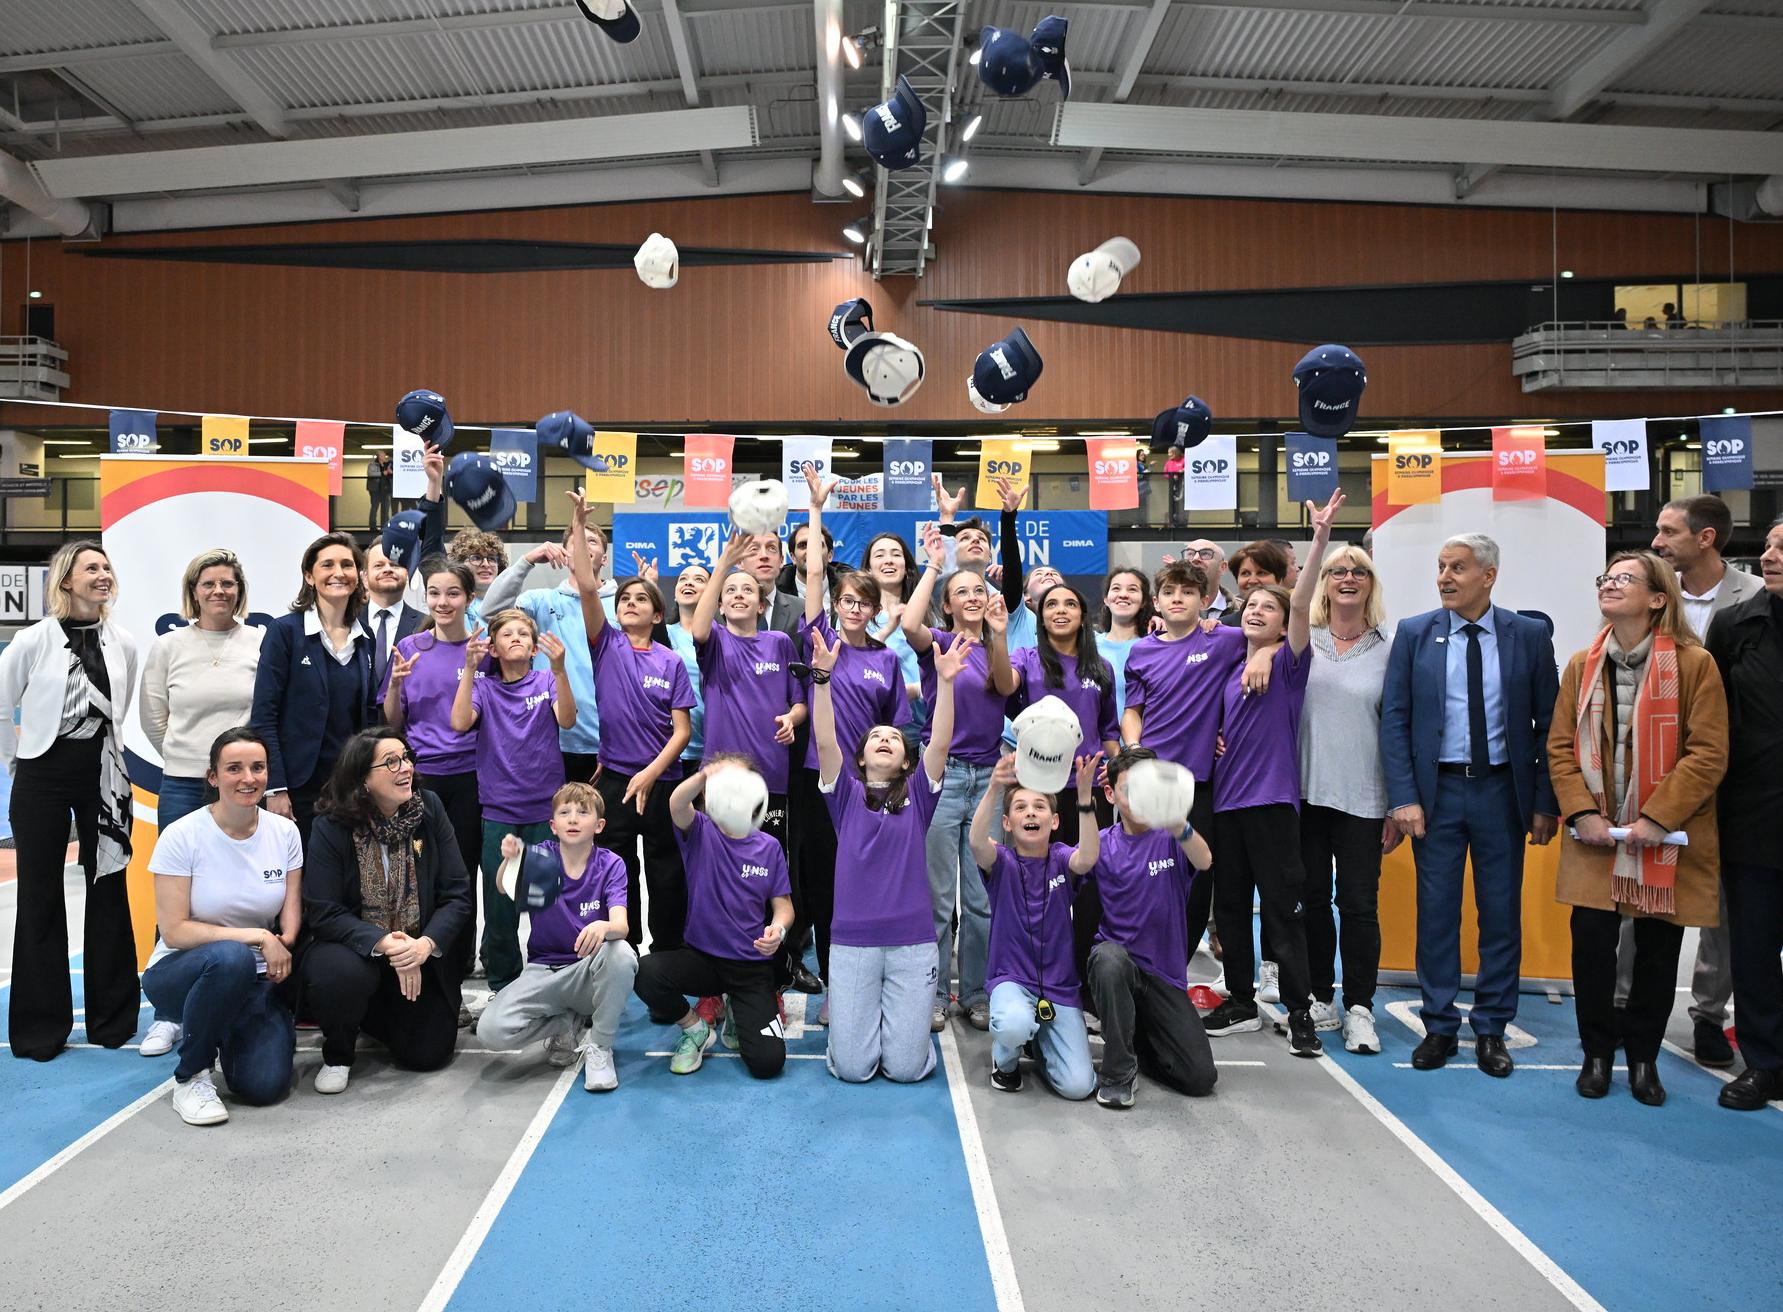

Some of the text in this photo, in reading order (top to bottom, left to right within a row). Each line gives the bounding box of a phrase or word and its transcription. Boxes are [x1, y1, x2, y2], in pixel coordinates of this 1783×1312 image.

[829, 314, 844, 342] FRANCE
[1314, 399, 1351, 411] FRANCE
[117, 433, 150, 448] SOP
[209, 438, 242, 451] SOP
[1601, 440, 1639, 455] SOP
[1706, 439, 1744, 455] SOP
[303, 446, 337, 458] SOP
[1498, 450, 1536, 465] SOP
[496, 452, 531, 467] SOP
[691, 458, 726, 472] SOP
[1192, 459, 1228, 473] SOP
[1292, 452, 1330, 467] SOP
[1395, 454, 1432, 468] SOP
[890, 461, 925, 475] SOP
[987, 460, 1022, 475] SOP
[1095, 460, 1129, 475] SOP
[837, 485, 879, 493] JEUNES
[860, 493, 879, 501] LES
[836, 501, 878, 510] JEUNES
[1026, 520, 1050, 536] DE
[2, 574, 25, 587] DE
[1029, 747, 1063, 763] FRANCE
[264, 869, 283, 878] SOP
